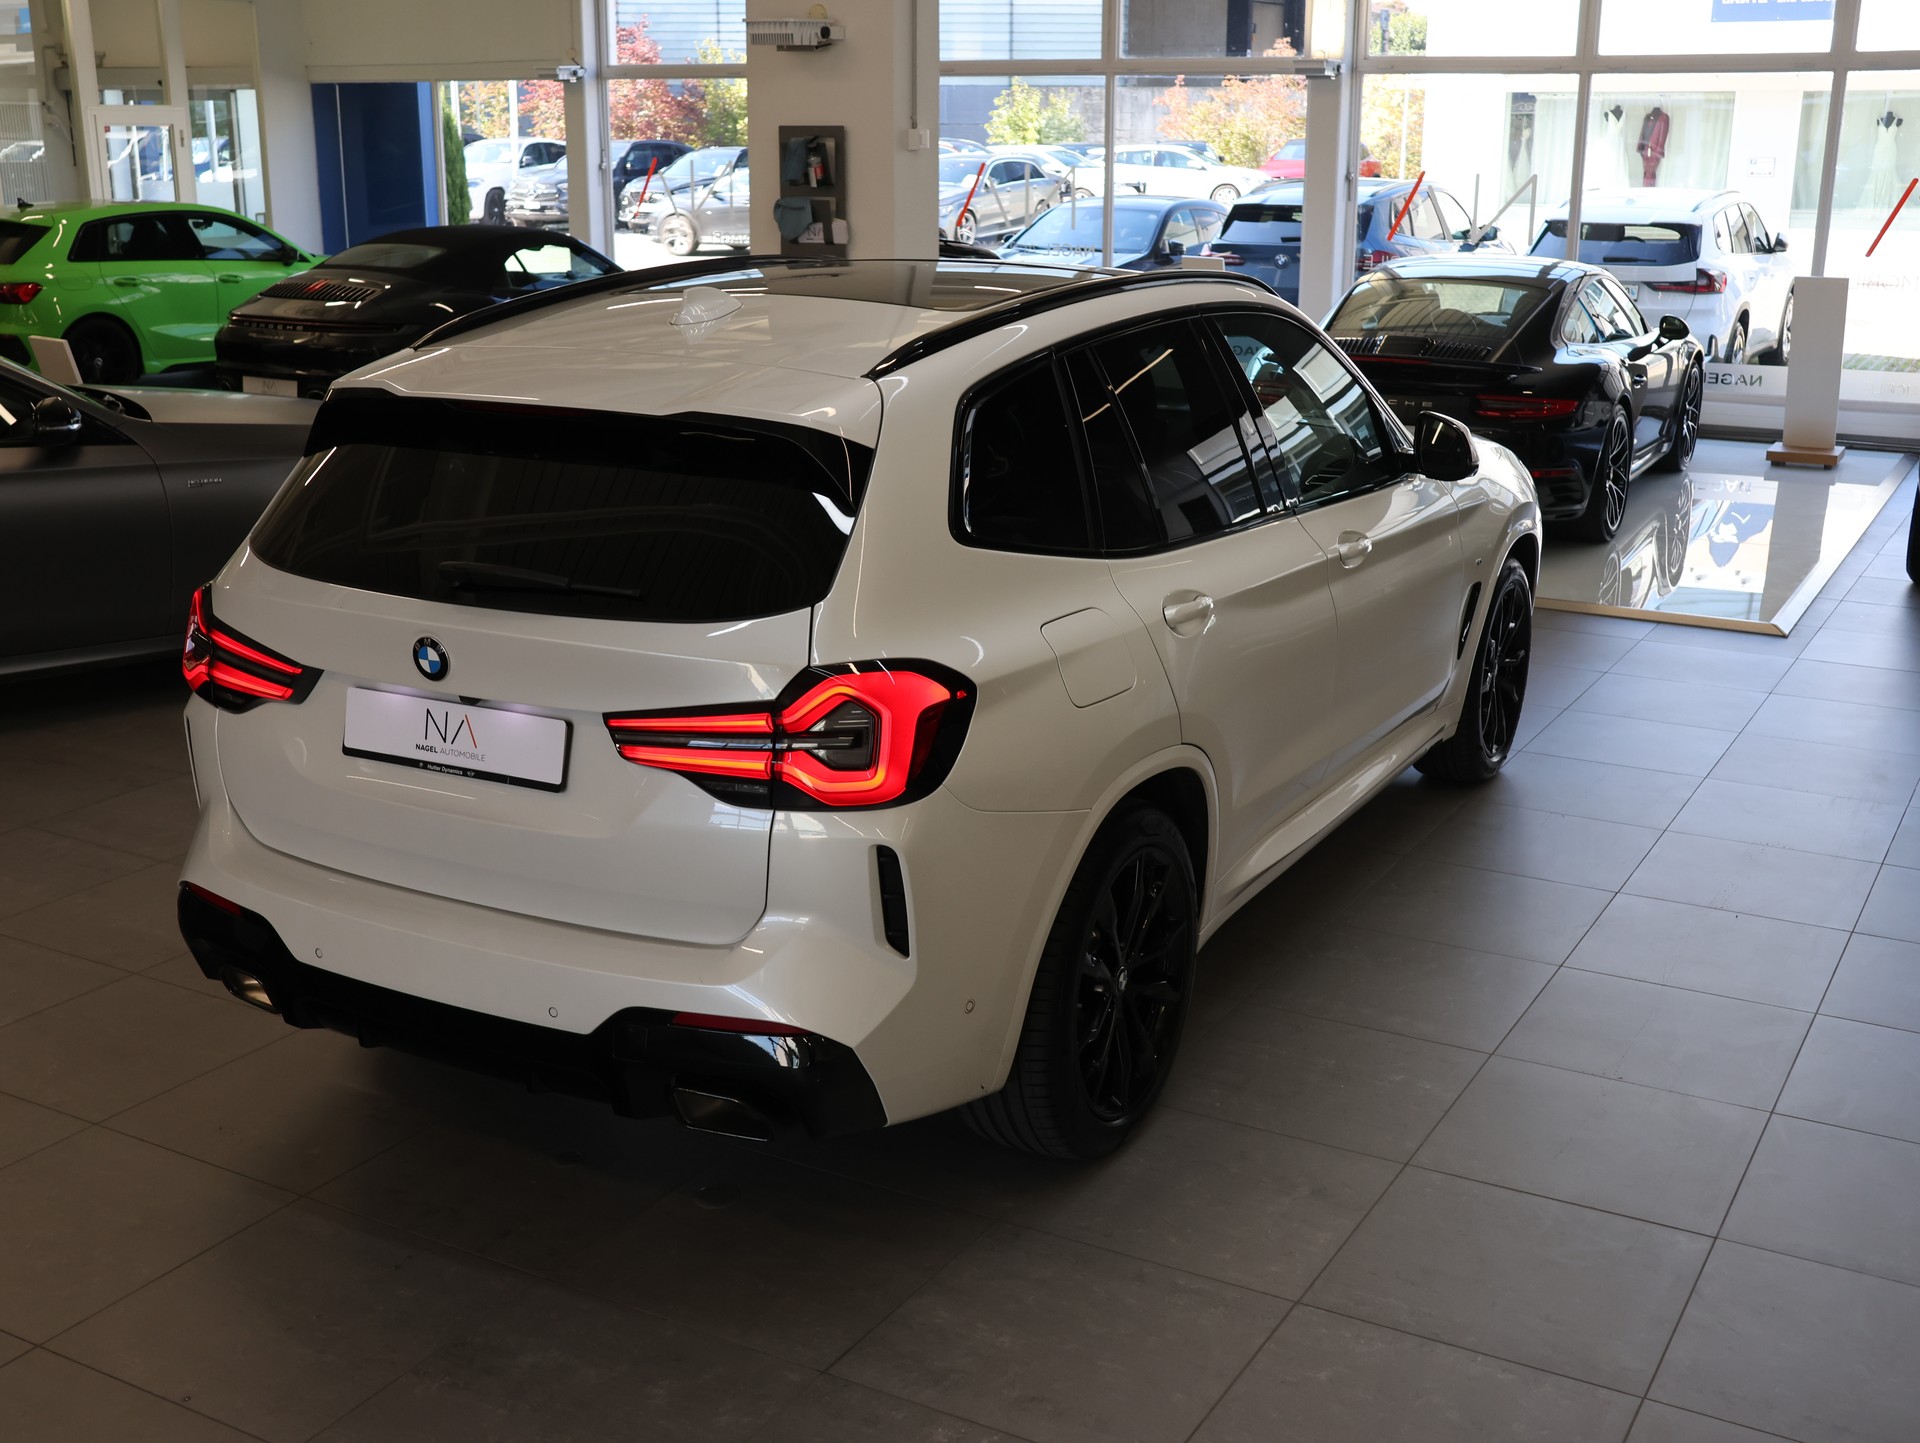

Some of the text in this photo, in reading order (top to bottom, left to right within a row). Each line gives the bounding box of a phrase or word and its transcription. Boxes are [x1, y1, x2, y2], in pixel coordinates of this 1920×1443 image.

[414, 638, 445, 654] BMW
[425, 707, 477, 748] NA
[415, 743, 486, 762] NAGEL AUTOMOBILE
[427, 763, 463, 775] Hutter Dynamics
